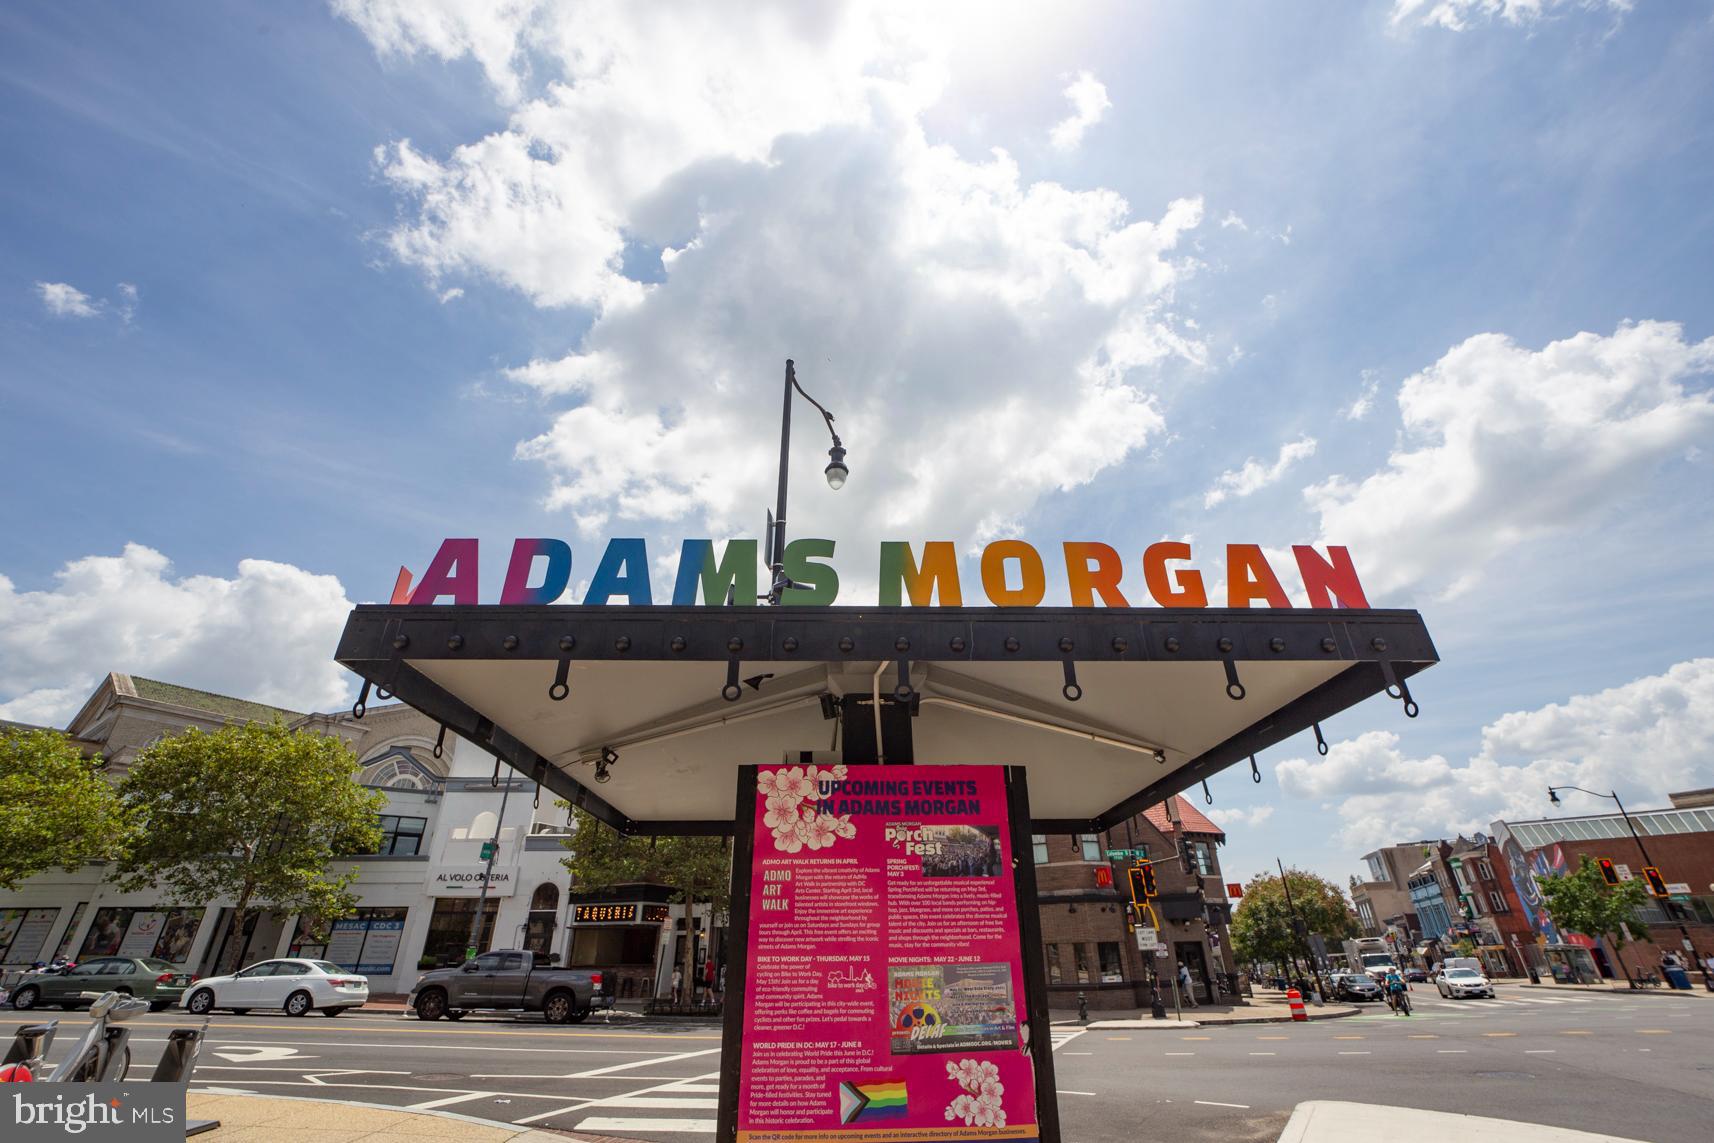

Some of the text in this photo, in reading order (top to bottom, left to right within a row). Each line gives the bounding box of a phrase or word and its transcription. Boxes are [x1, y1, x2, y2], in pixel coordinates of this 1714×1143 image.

[410, 538, 1370, 609] ADAMS MORGAN
[818, 780, 976, 796] UPCOMING EVENTS
[817, 800, 980, 815] IN ADAMS MORGAN
[885, 828, 934, 841] Porch
[906, 841, 943, 855] Fest
[437, 874, 448, 882] AL
[474, 873, 509, 881] OERIA
[764, 870, 791, 881] ADMO
[763, 884, 782, 896] ART
[762, 899, 789, 910] WALK
[828, 1058, 838, 1066] part
